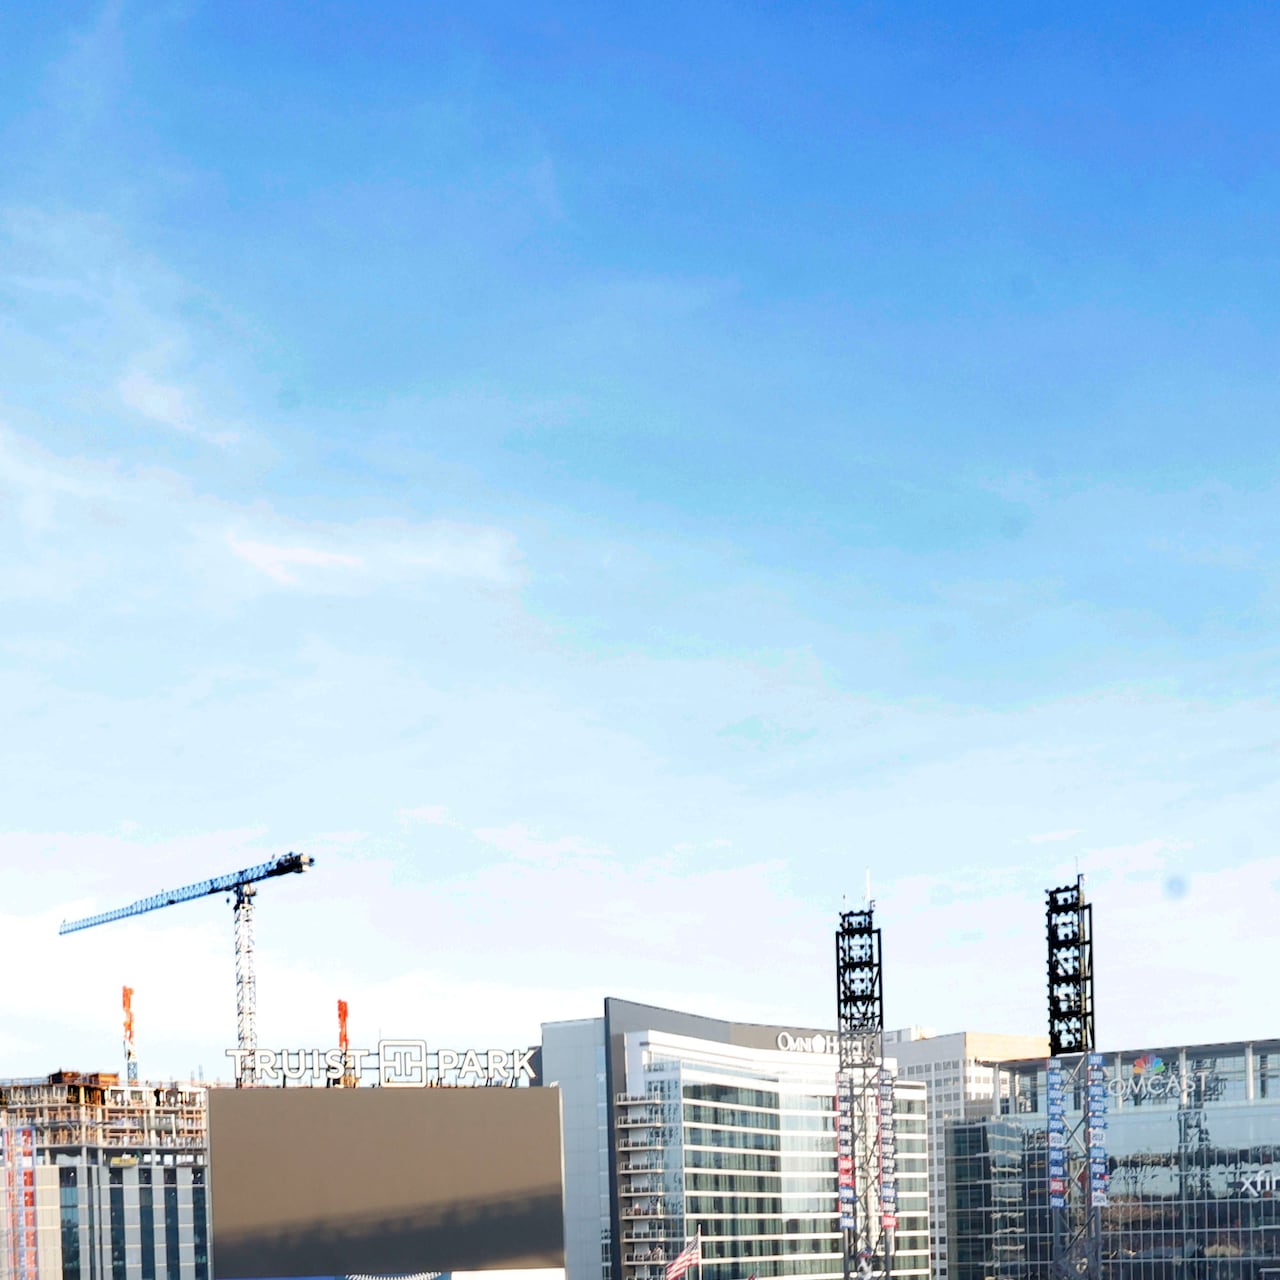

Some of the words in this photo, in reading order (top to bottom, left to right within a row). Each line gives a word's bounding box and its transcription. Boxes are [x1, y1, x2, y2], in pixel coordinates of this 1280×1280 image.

[225, 1049, 370, 1080] TRUIST
[437, 1049, 538, 1080] PARK
[1108, 1071, 1210, 1100] OMCAST
